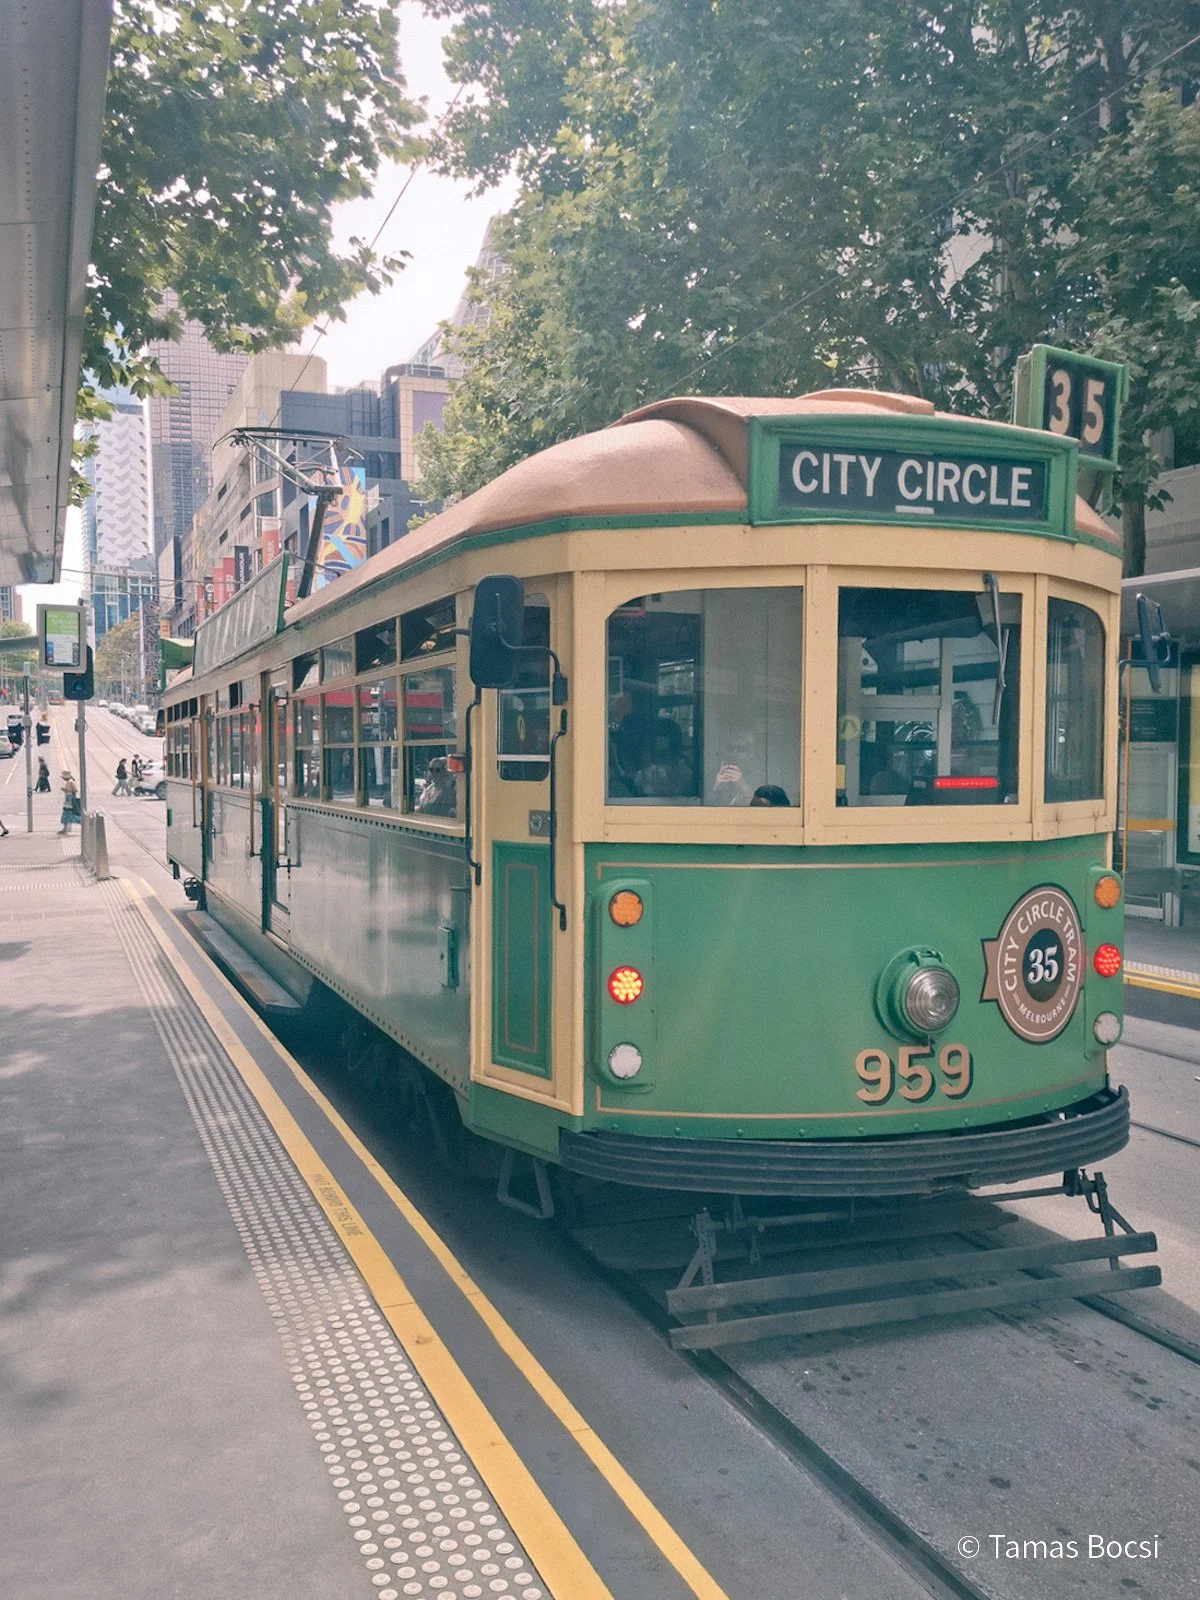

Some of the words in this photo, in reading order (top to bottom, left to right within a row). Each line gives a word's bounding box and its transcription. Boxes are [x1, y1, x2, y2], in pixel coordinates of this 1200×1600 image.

[1048, 369, 1106, 445] 35
[792, 450, 882, 497] CITY
[897, 458, 1033, 507] CIRCLE
[1004, 936, 1020, 991] CITY
[1017, 900, 1064, 935] CIRCLE
[1062, 917, 1078, 982] TRAM
[1027, 945, 1058, 984] 35
[1019, 997, 1067, 1024] MELBOURNE
[855, 1043, 973, 1105] 959
